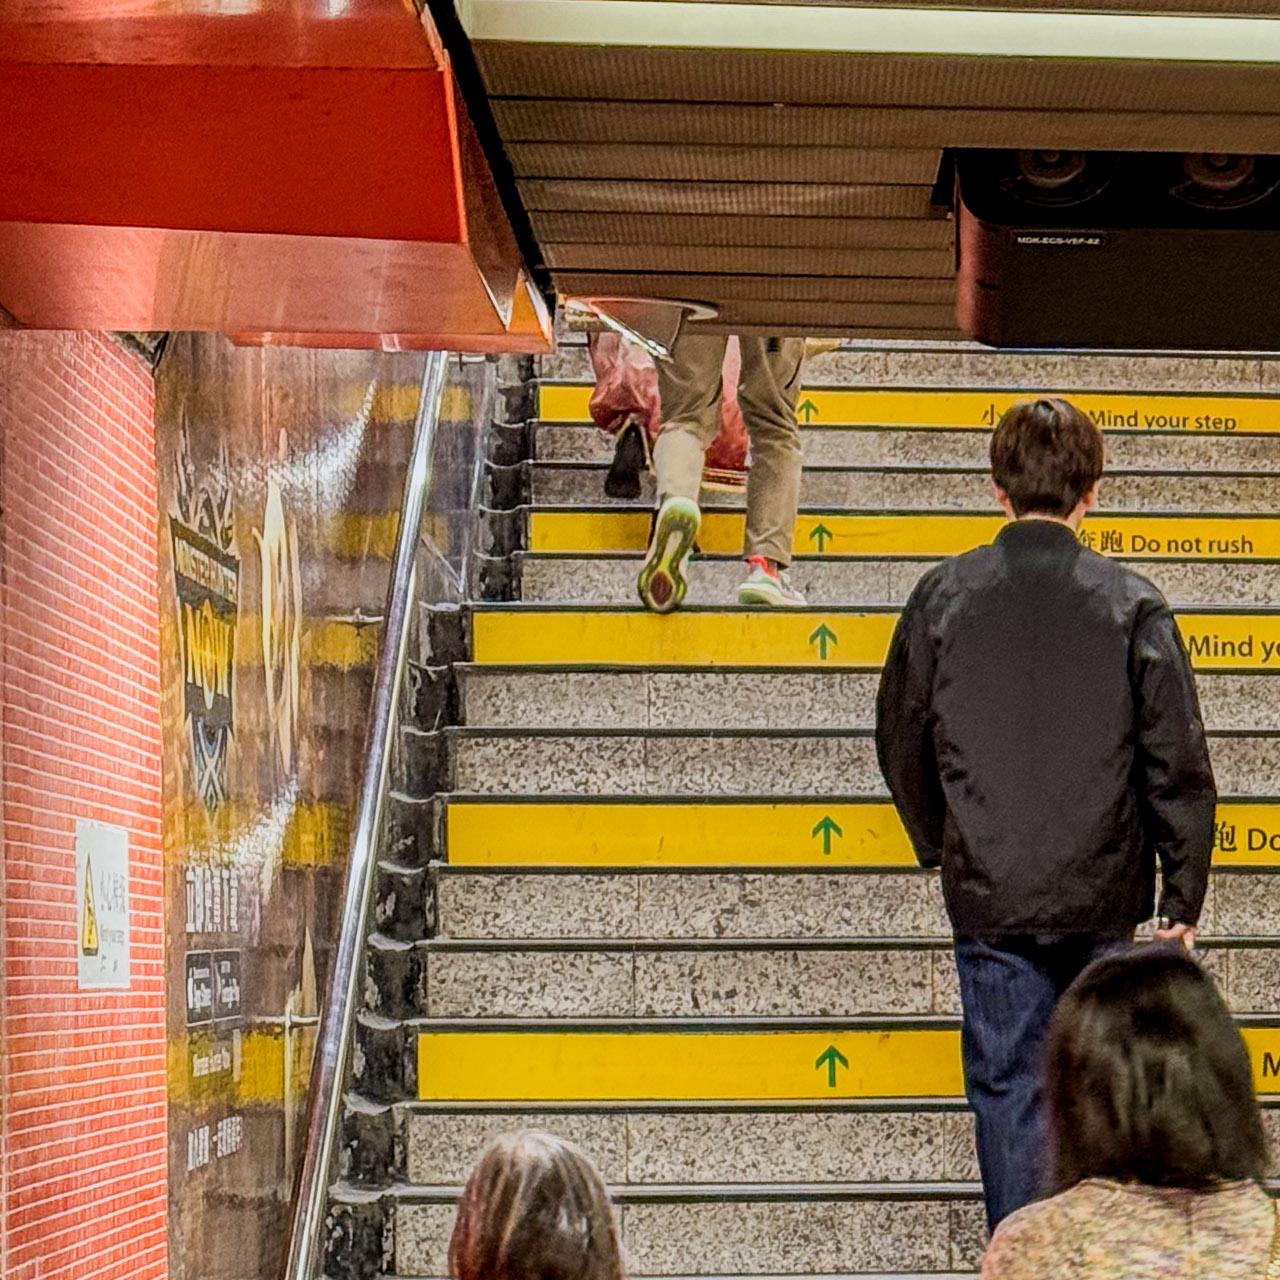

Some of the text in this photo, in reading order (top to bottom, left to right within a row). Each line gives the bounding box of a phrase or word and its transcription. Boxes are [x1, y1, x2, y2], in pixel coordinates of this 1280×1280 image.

[1089, 409, 1138, 427] Mind
[1144, 414, 1189, 430] your
[1195, 413, 1236, 431] step
[1131, 534, 1160, 553] Do
[1167, 536, 1202, 553] not
[1208, 534, 1253, 553] rush
[1188, 634, 1253, 658] Mind
